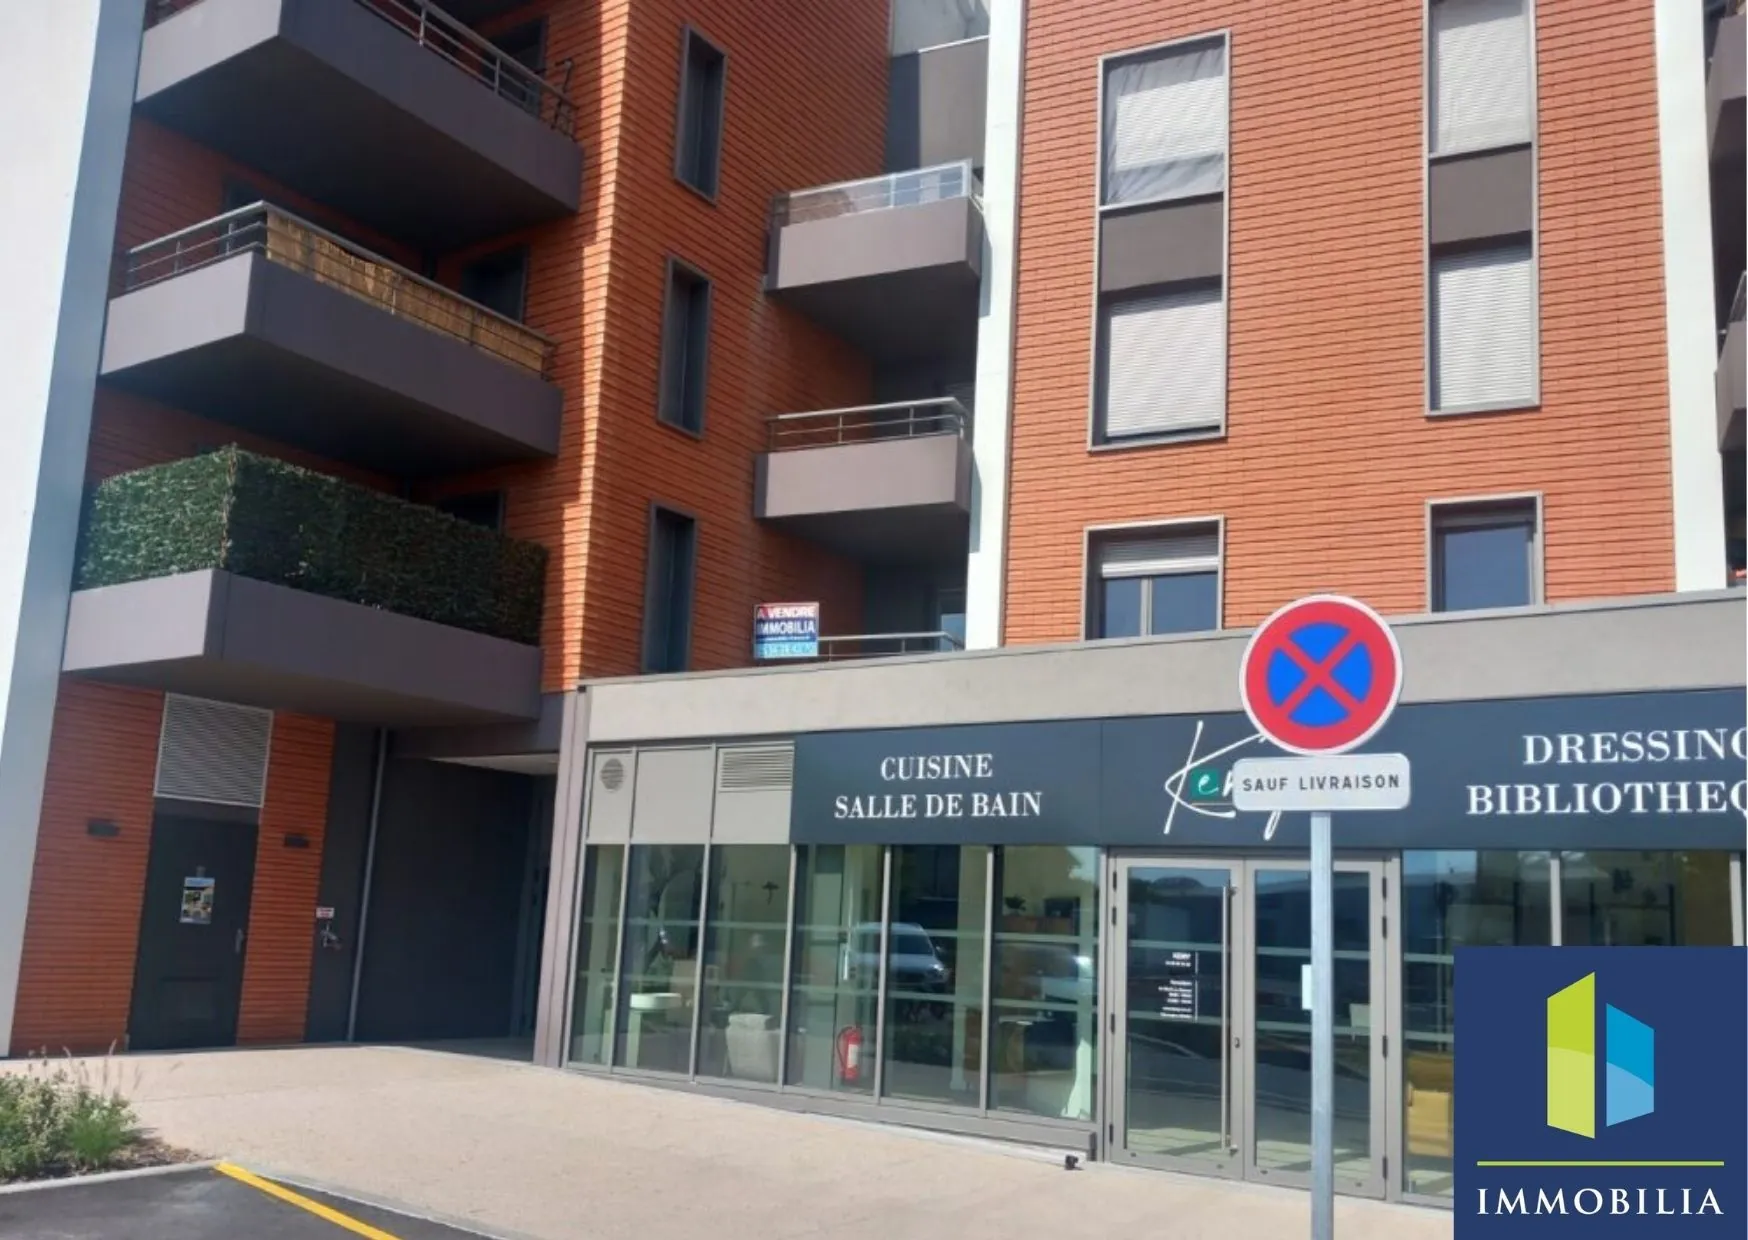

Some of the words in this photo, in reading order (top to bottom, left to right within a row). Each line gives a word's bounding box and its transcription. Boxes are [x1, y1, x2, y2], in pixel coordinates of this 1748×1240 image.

[767, 605, 816, 619] VENDRE
[757, 620, 816, 635] IMMOBILIA
[880, 753, 993, 781] CUISINE
[1242, 777, 1289, 792] SAUF
[1299, 774, 1400, 791] LIVRAISON
[834, 794, 917, 819] SALLE
[924, 793, 963, 818] DE
[971, 791, 1043, 817] BAIN
[1466, 779, 1747, 820] BIBLIOTHEQ
